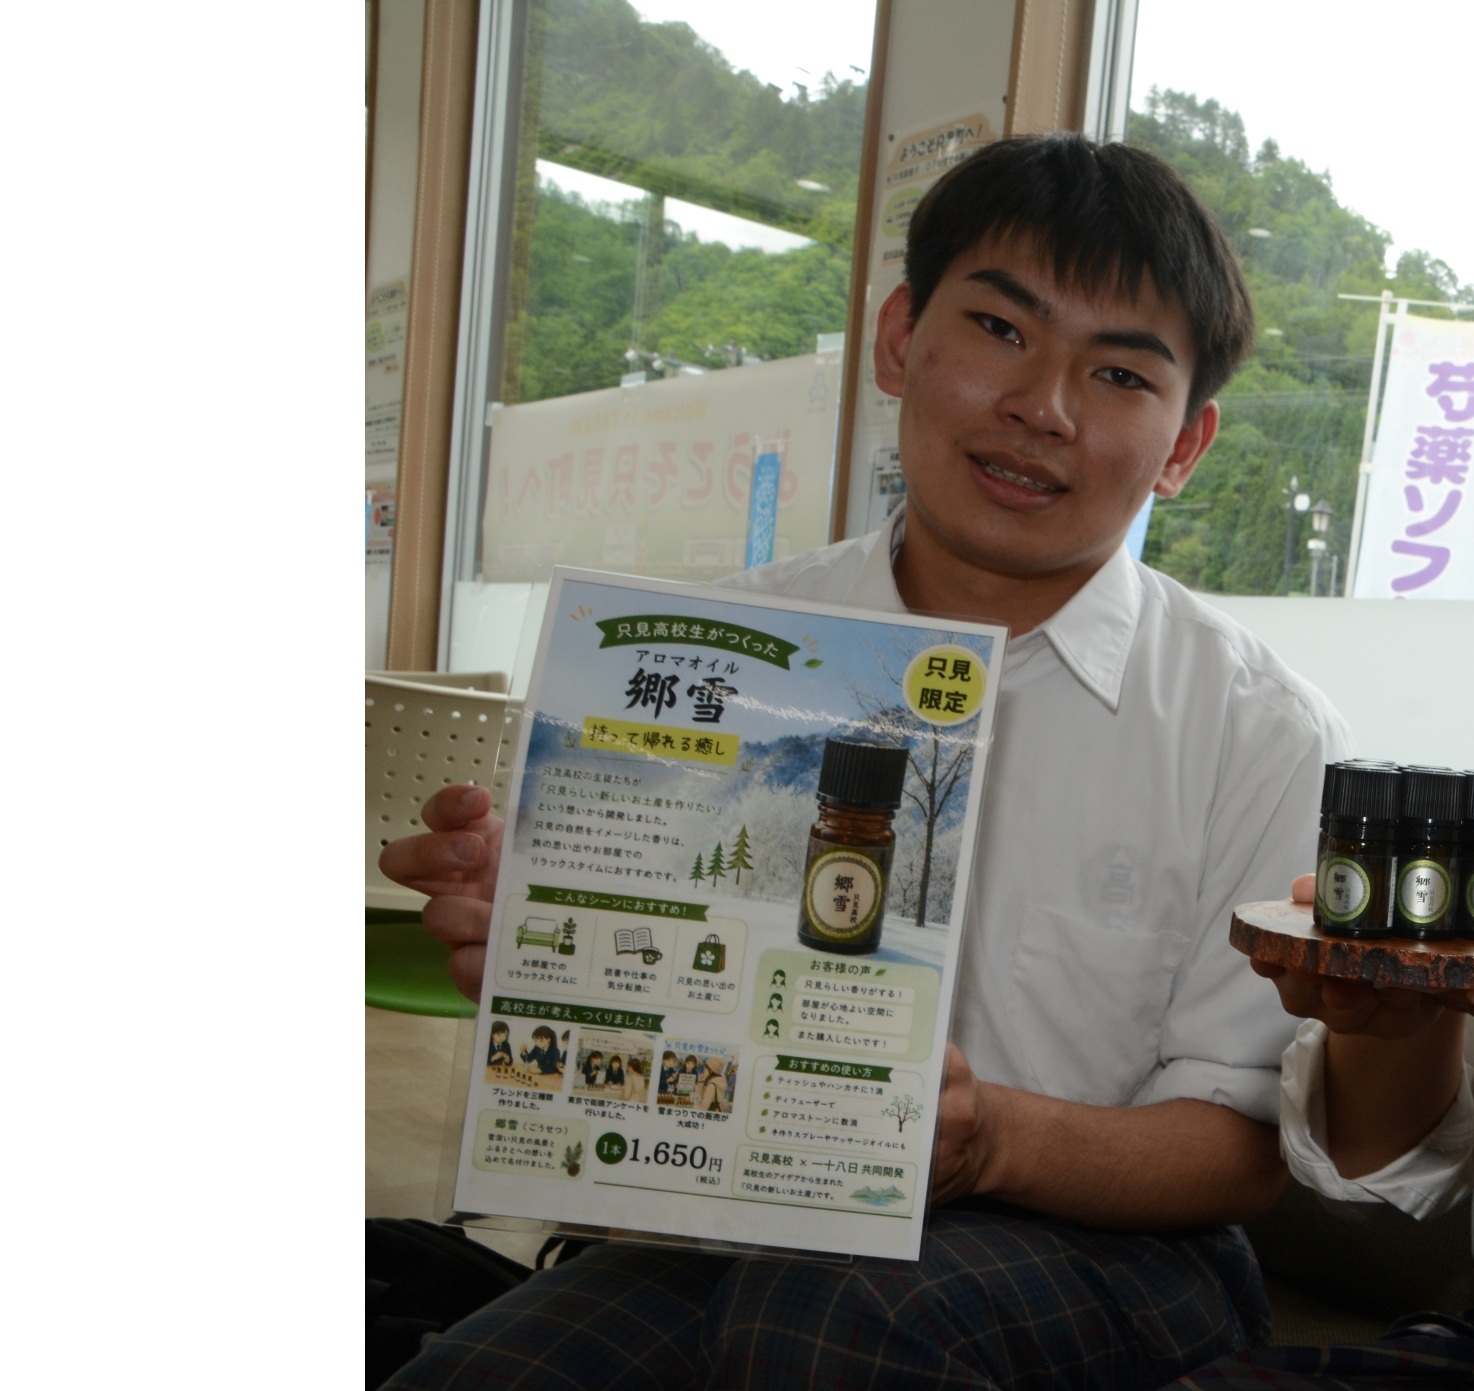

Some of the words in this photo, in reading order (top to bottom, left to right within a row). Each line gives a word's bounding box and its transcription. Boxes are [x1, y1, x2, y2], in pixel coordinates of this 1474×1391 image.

[616, 621, 779, 659] 只見高校生がつくった
[636, 650, 740, 675] アロマオイル
[924, 656, 972, 683] 只見
[624, 667, 739, 724] 郷雪
[918, 687, 968, 714] 限定
[589, 724, 726, 757] 持って帰れる癒し
[542, 766, 643, 787] 只見高校の生徒たちが
[539, 782, 723, 816] 「只見らしい新しいお土産を作りたい」
[537, 802, 667, 826] という想いから開発しました。
[534, 820, 686, 848] 只見の自然をイメージした香りは、
[532, 838, 643, 860] 旅の思い出やお部屋での
[530, 856, 678, 882] リラックスタイムにおすすめです。
[554, 891, 688, 916] こんなシーンにおすすめ！
[833, 874, 854, 913] 郷雪
[522, 958, 567, 972] お部屋での
[604, 967, 657, 982] 読書や仕事の
[810, 959, 872, 977] お客様の声
[507, 969, 578, 986] リラックスタイムに
[607, 980, 651, 994] 気分転換に
[676, 975, 736, 991] 只見の思い出の
[687, 990, 721, 1002] お土産に
[804, 980, 903, 999] 只見らしい香りがする！
[500, 1000, 654, 1028] 高校生が考え、つくりました！
[802, 998, 894, 1018] 部屋が心地よい空間に
[800, 1011, 850, 1026] なりました。
[798, 1030, 887, 1049] また購入したいです！
[788, 1058, 873, 1079] おすすめの使い方
[492, 1087, 554, 1102] ブレンドを三種類
[777, 1075, 884, 1096] ティッシュやハンカチに1滴
[498, 1099, 541, 1111] 作りました。
[567, 1095, 650, 1114] 東京で街頭アンケートを
[585, 1108, 627, 1121] 行いました。
[657, 1106, 729, 1122] 雪まつりでの販売が
[676, 1119, 706, 1130] 大成功！
[772, 1110, 859, 1128] アロマストーンに数滴
[484, 1155, 556, 1171] 込めて名付けました。
[602, 1140, 622, 1157] 1本
[629, 1137, 723, 1173] 1,650円
[748, 1151, 794, 1167] 只見高校
[861, 1163, 905, 1179] 共同開発
[743, 1168, 844, 1188] 高校生のアイデアから生まれた
[741, 1183, 835, 1201] 「只見の新しいお土産」です。
